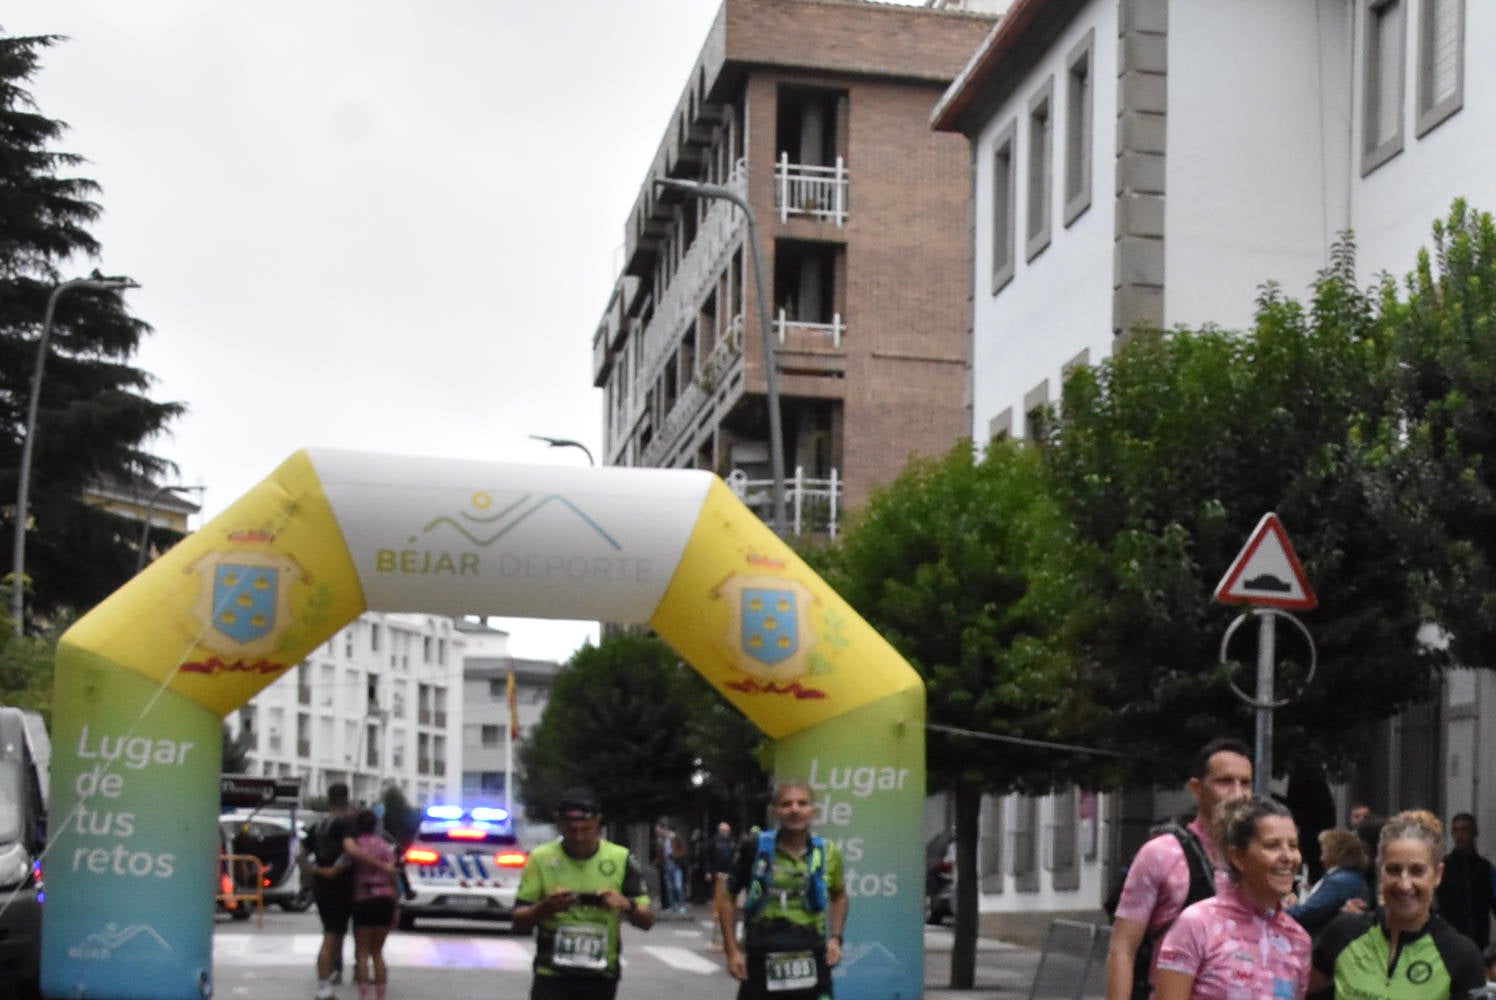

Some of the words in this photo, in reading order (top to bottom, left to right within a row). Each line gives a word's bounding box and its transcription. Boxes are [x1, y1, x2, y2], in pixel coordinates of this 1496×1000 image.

[375, 535, 480, 575] BÉJAR
[500, 552, 656, 583] DEPORTE
[77, 724, 194, 770] Lugar
[75, 763, 124, 798] de
[809, 757, 910, 797] Lugar
[73, 803, 136, 837] tus
[810, 794, 852, 826] de
[72, 845, 176, 878] retos
[845, 868, 897, 897] tos
